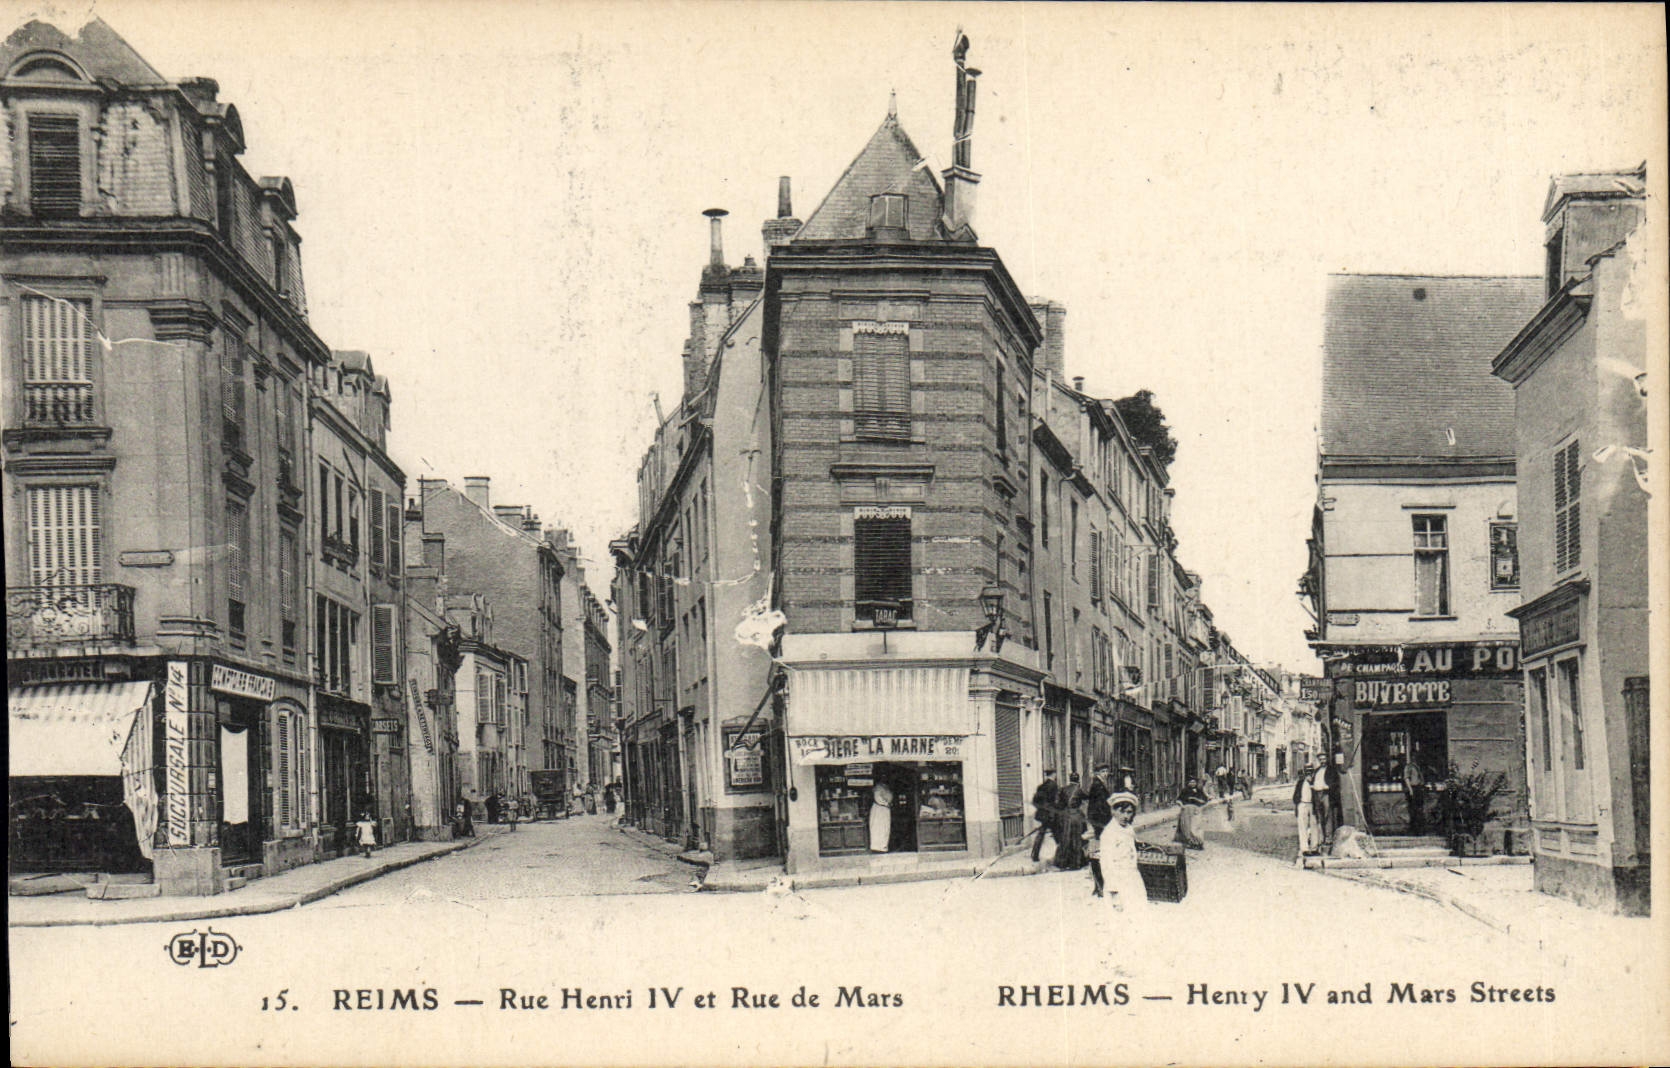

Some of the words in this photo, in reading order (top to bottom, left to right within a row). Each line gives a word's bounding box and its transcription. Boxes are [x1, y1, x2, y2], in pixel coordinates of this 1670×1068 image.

[875, 609, 898, 624] TABAC
[1410, 649, 1453, 672] AU
[1355, 680, 1451, 704] BUVETTE
[169, 719, 187, 841] SUCCURSALE
